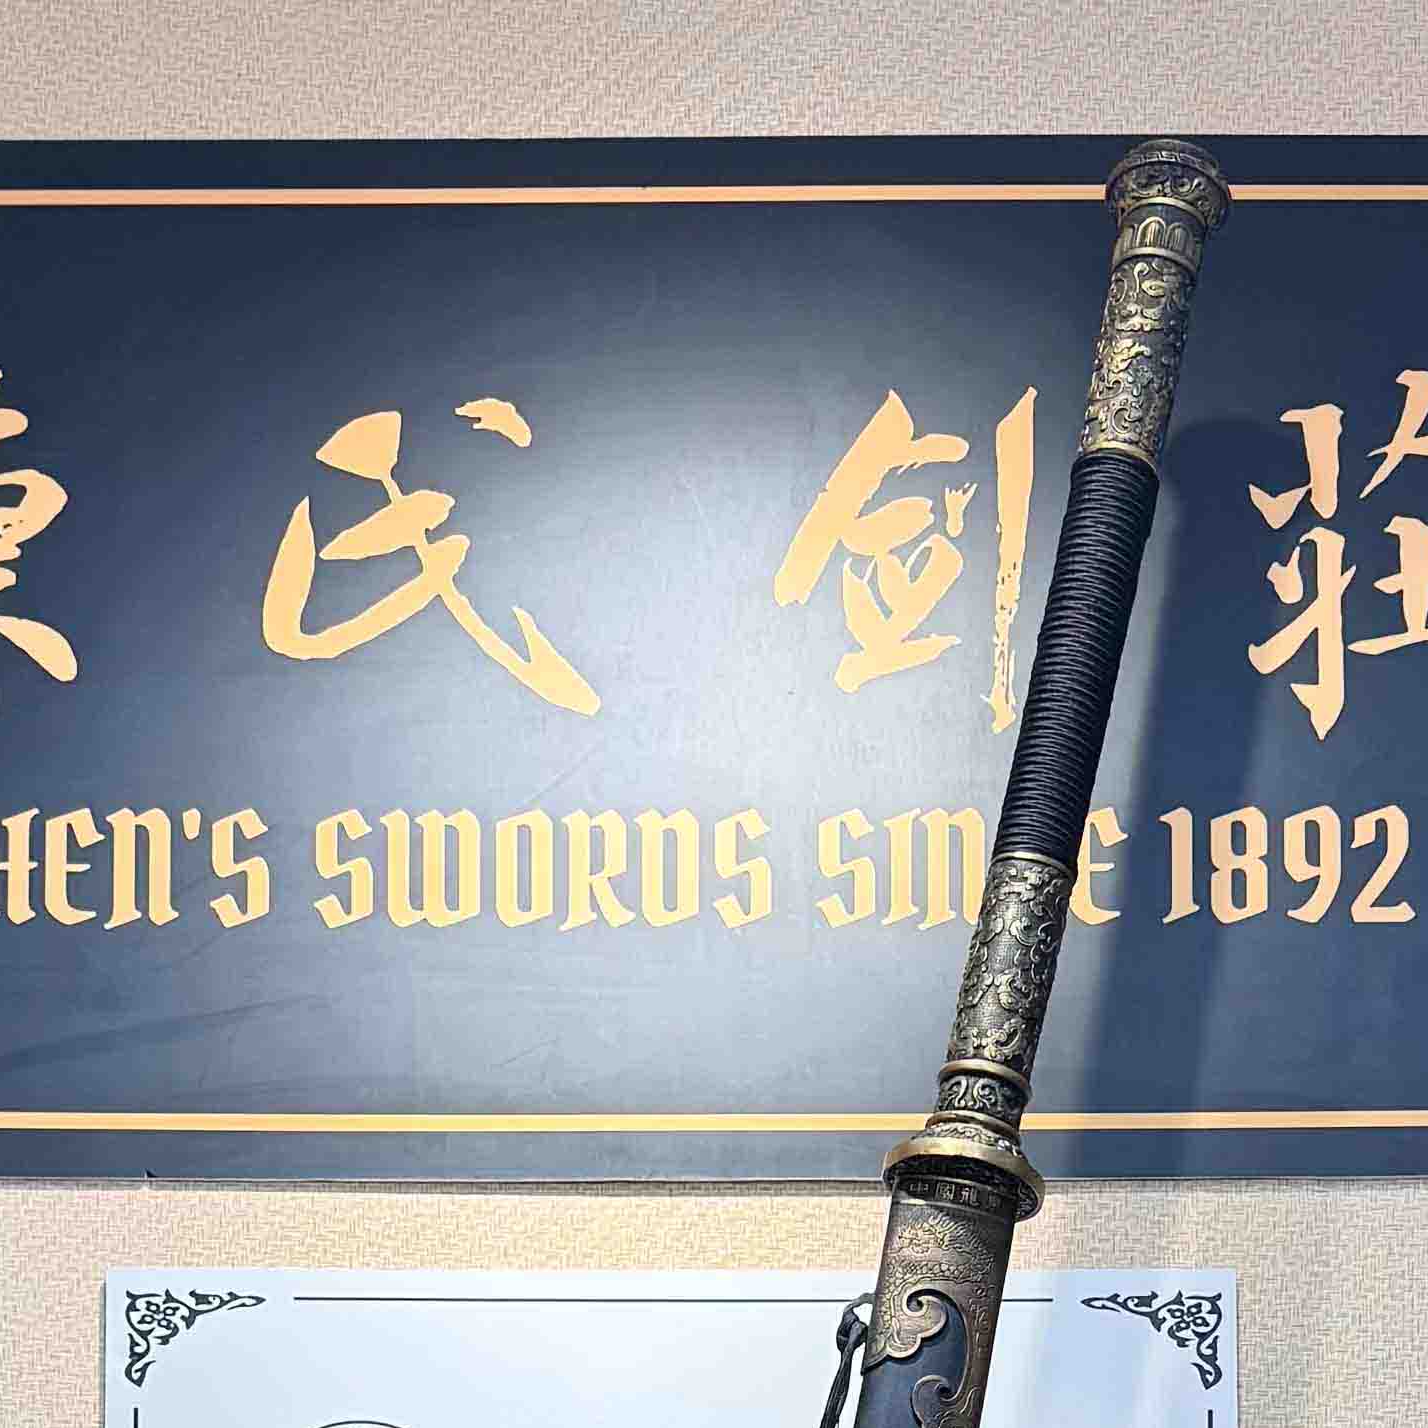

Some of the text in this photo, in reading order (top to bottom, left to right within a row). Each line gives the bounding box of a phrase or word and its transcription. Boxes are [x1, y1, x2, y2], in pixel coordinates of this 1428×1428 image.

[314, 809, 772, 929] SWORDS
[815, 807, 1129, 929] SINE
[1162, 804, 1416, 924] 1892
